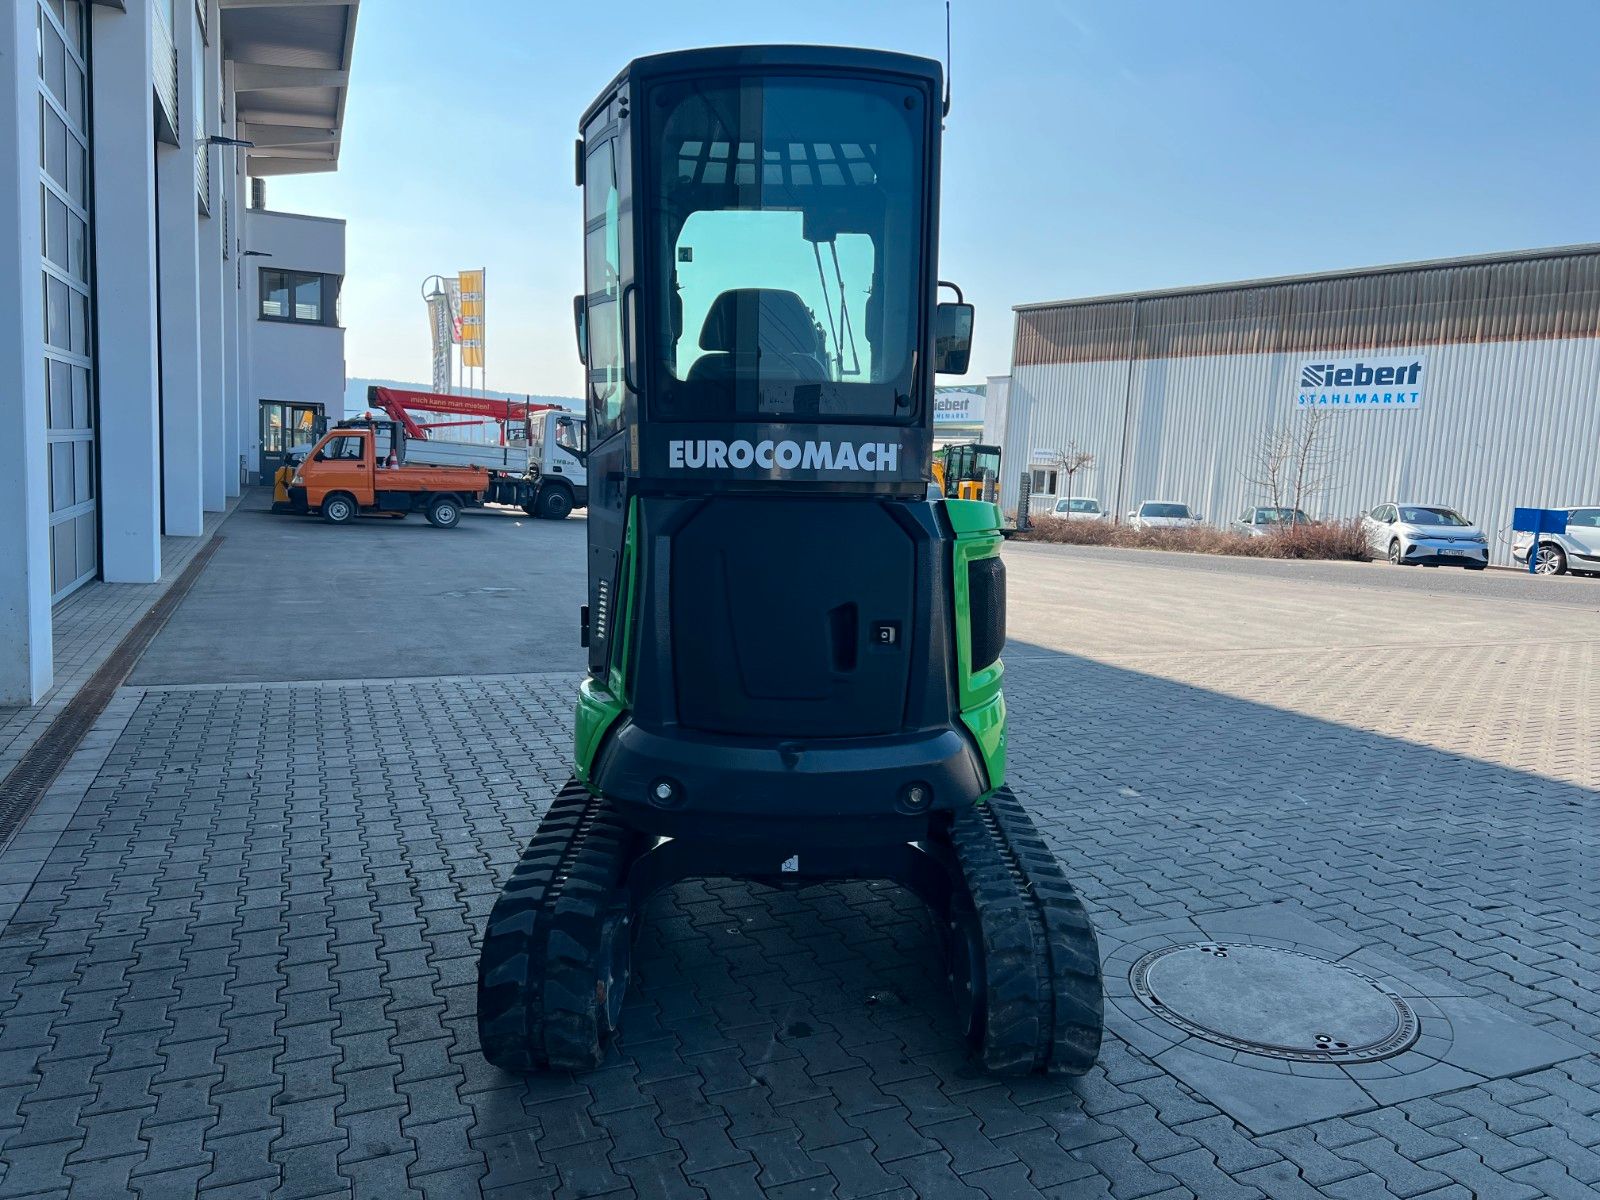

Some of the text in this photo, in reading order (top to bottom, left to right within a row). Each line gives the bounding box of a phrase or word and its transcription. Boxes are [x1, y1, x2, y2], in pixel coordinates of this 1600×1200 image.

[1301, 361, 1422, 387] Siebert
[934, 398, 970, 411] iebert
[1298, 392, 1418, 404] STAHLMARKT
[669, 440, 898, 471] EUROCOMACH
